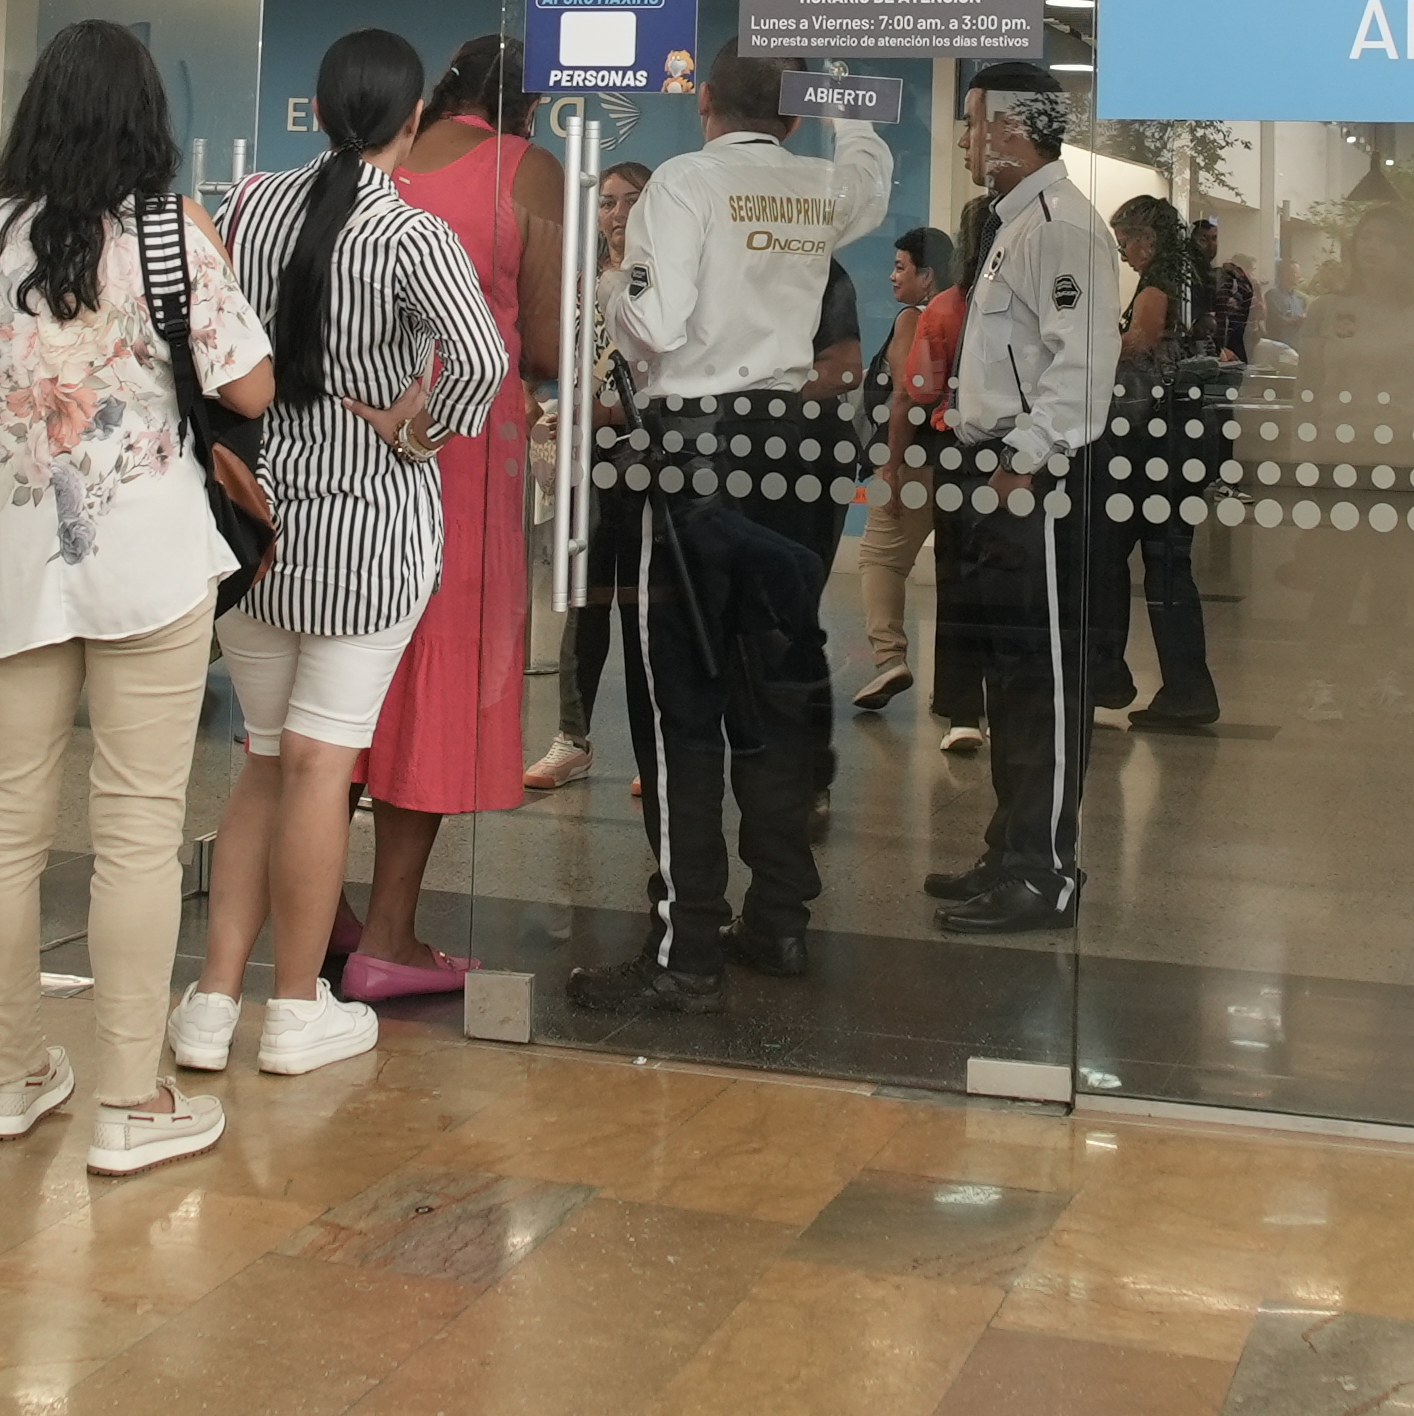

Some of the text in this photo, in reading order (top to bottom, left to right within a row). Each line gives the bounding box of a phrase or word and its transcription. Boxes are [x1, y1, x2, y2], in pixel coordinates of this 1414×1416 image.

[751, 15, 1031, 33] Lunes a Viernes: 7:00 am. a 3:00 pm.
[751, 35, 1029, 48] No presta servicio de atención los días festivos
[549, 70, 648, 87] PERSONAS
[804, 87, 877, 106] ABIERTO
[729, 195, 794, 224] SEGURIDAD
